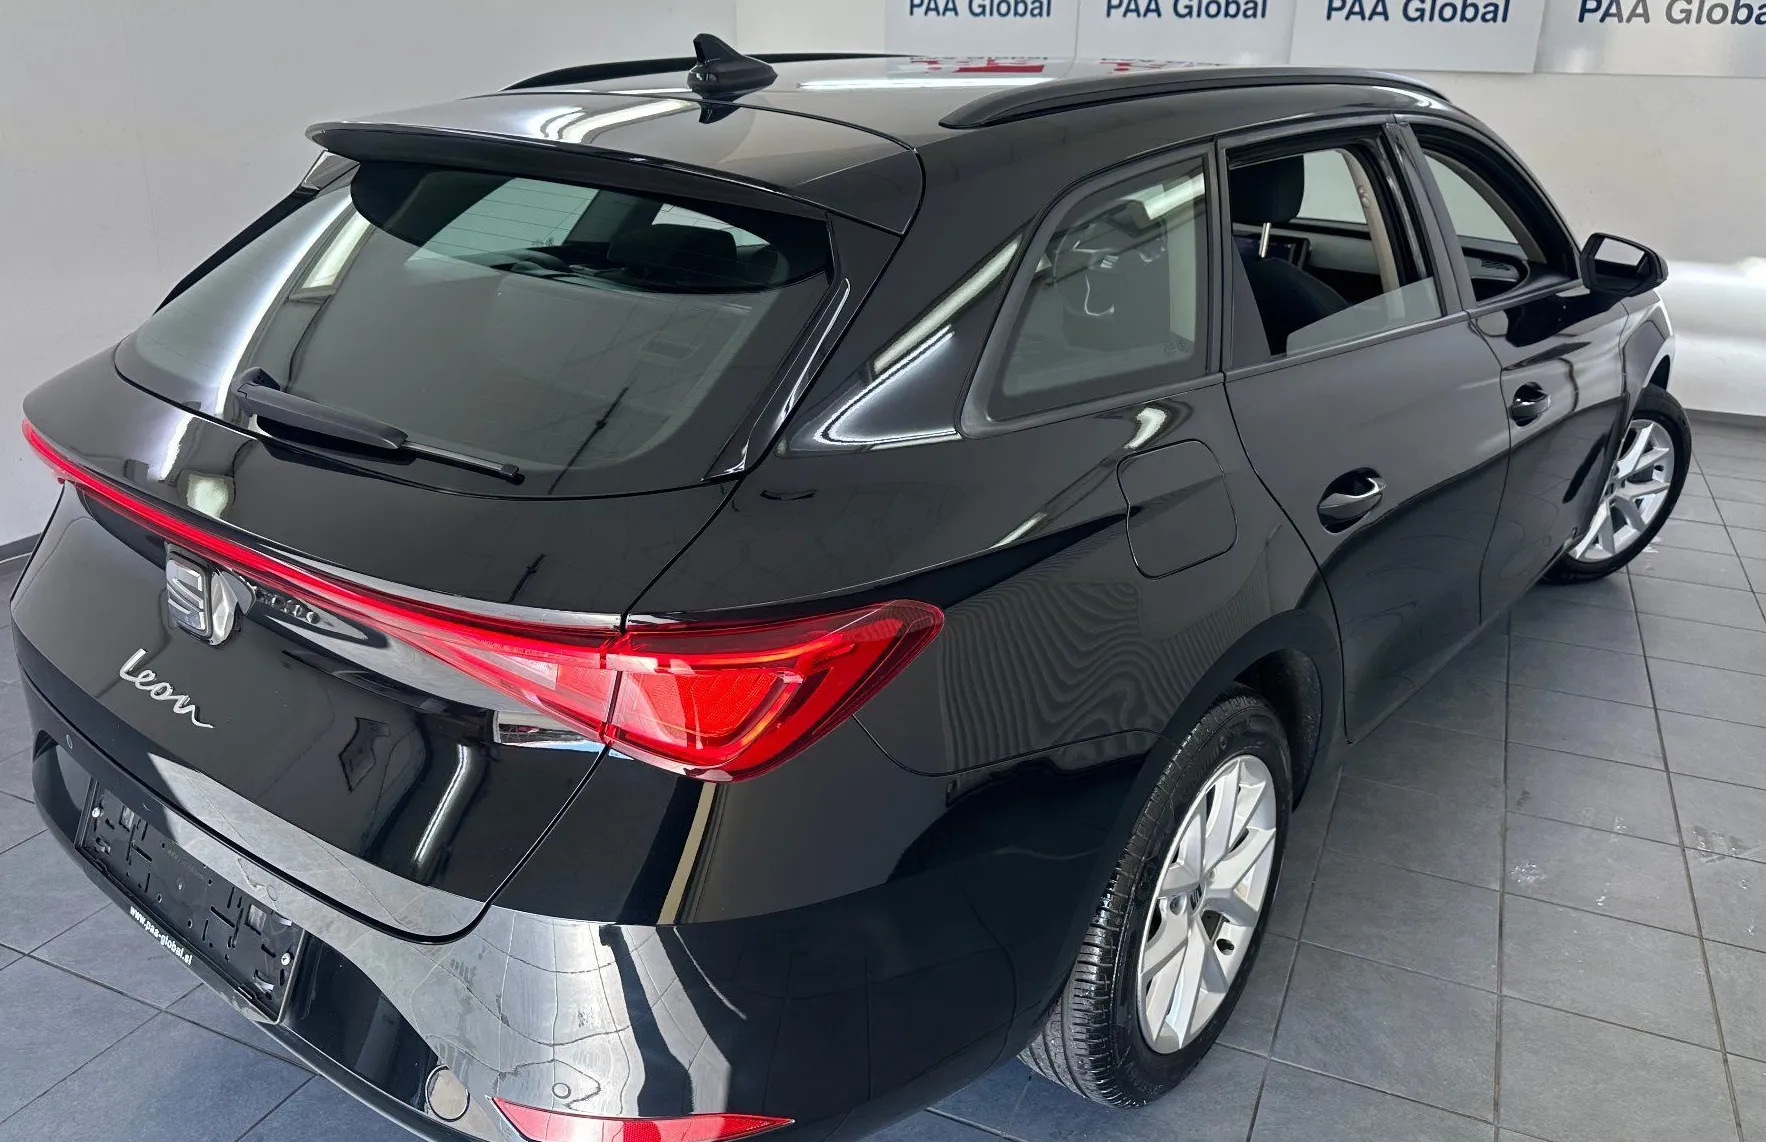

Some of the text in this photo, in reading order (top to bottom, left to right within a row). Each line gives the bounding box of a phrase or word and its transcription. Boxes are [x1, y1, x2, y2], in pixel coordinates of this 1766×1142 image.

[909, 0, 1052, 18] PAA Global
[1106, 0, 1267, 19] PAA Global
[1326, 0, 1510, 24] PAA Global
[1577, 0, 1650, 24] PAA
[119, 648, 215, 729] Leon
